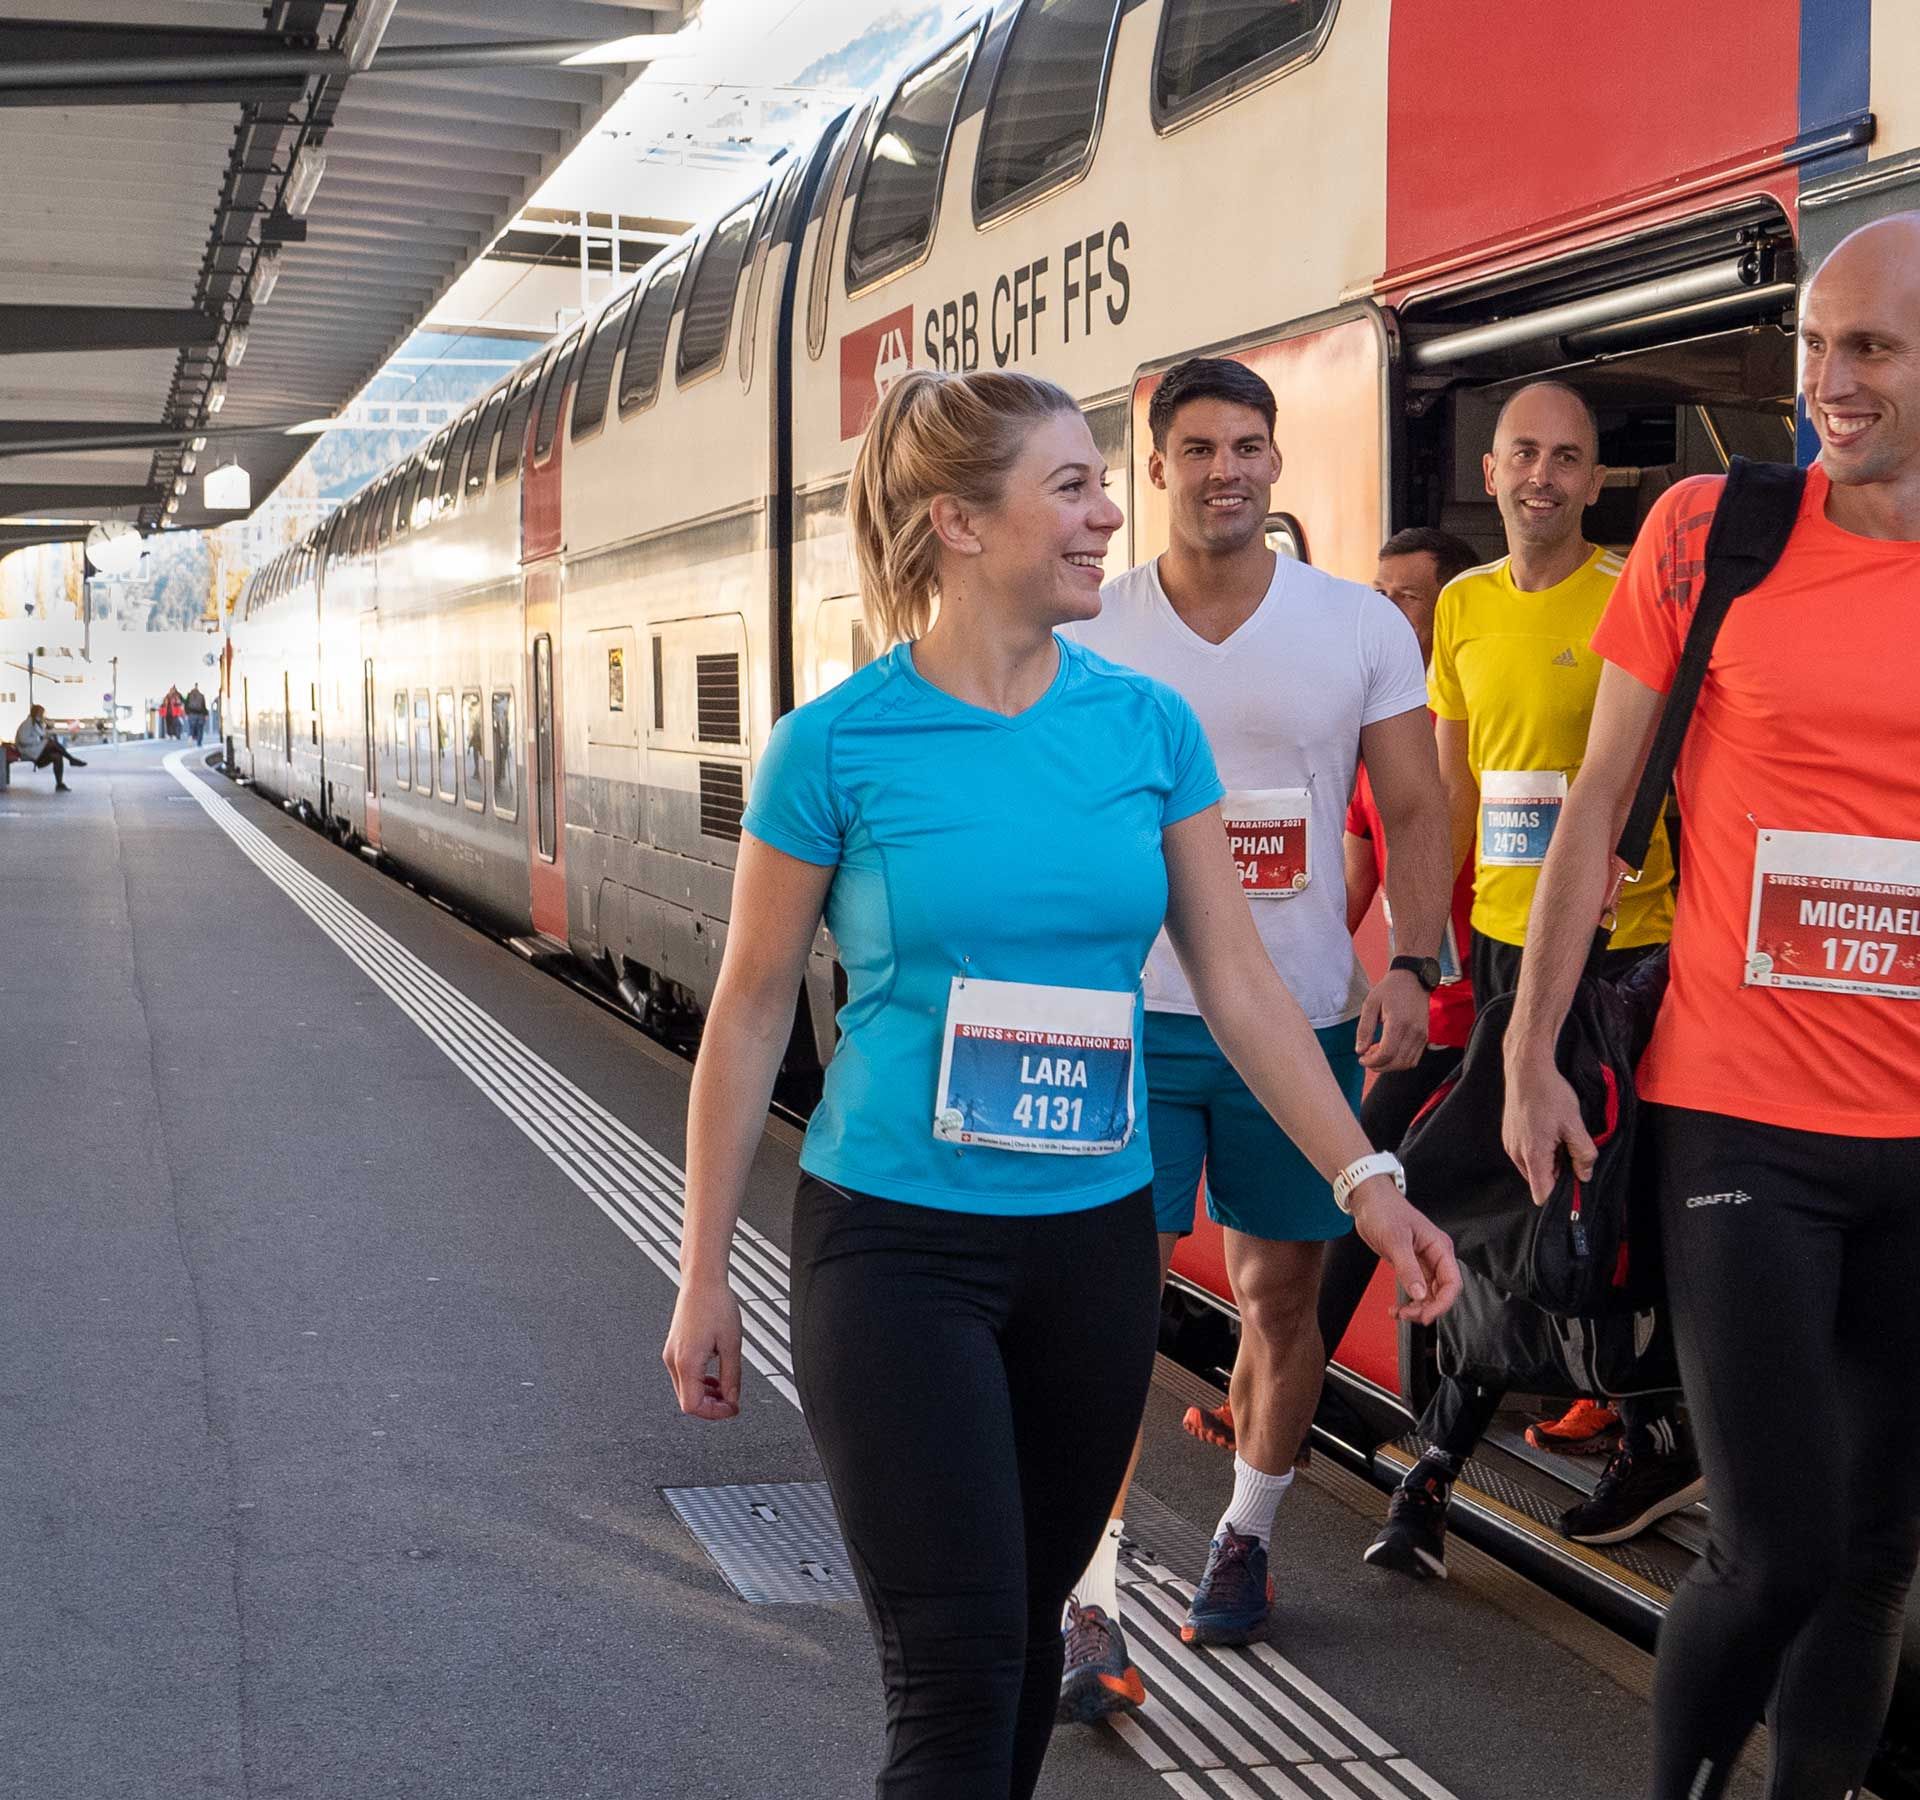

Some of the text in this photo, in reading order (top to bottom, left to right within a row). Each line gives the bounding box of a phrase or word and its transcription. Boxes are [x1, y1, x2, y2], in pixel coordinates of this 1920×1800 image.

[925, 221, 1130, 373] SBB CFF FFS
[1231, 820, 1280, 829] MARATHON
[1282, 819, 1301, 828] 2021
[1487, 811, 1540, 828] THOMAS
[1227, 835, 1284, 855] PHAN
[1493, 832, 1528, 853] 2479
[1768, 874, 1809, 887] SWISS
[1820, 878, 1850, 891] CITY
[1799, 899, 1920, 936] MICHAEL
[1822, 937, 1899, 976] 1767
[962, 1025, 1003, 1040] SWISS
[1015, 1031, 1045, 1044] CITY
[1046, 1033, 1111, 1049] MARATHON
[1020, 1055, 1088, 1088] LARA
[1013, 1094, 1083, 1132] 4131
[1686, 1193, 1734, 1208] CRAFT
